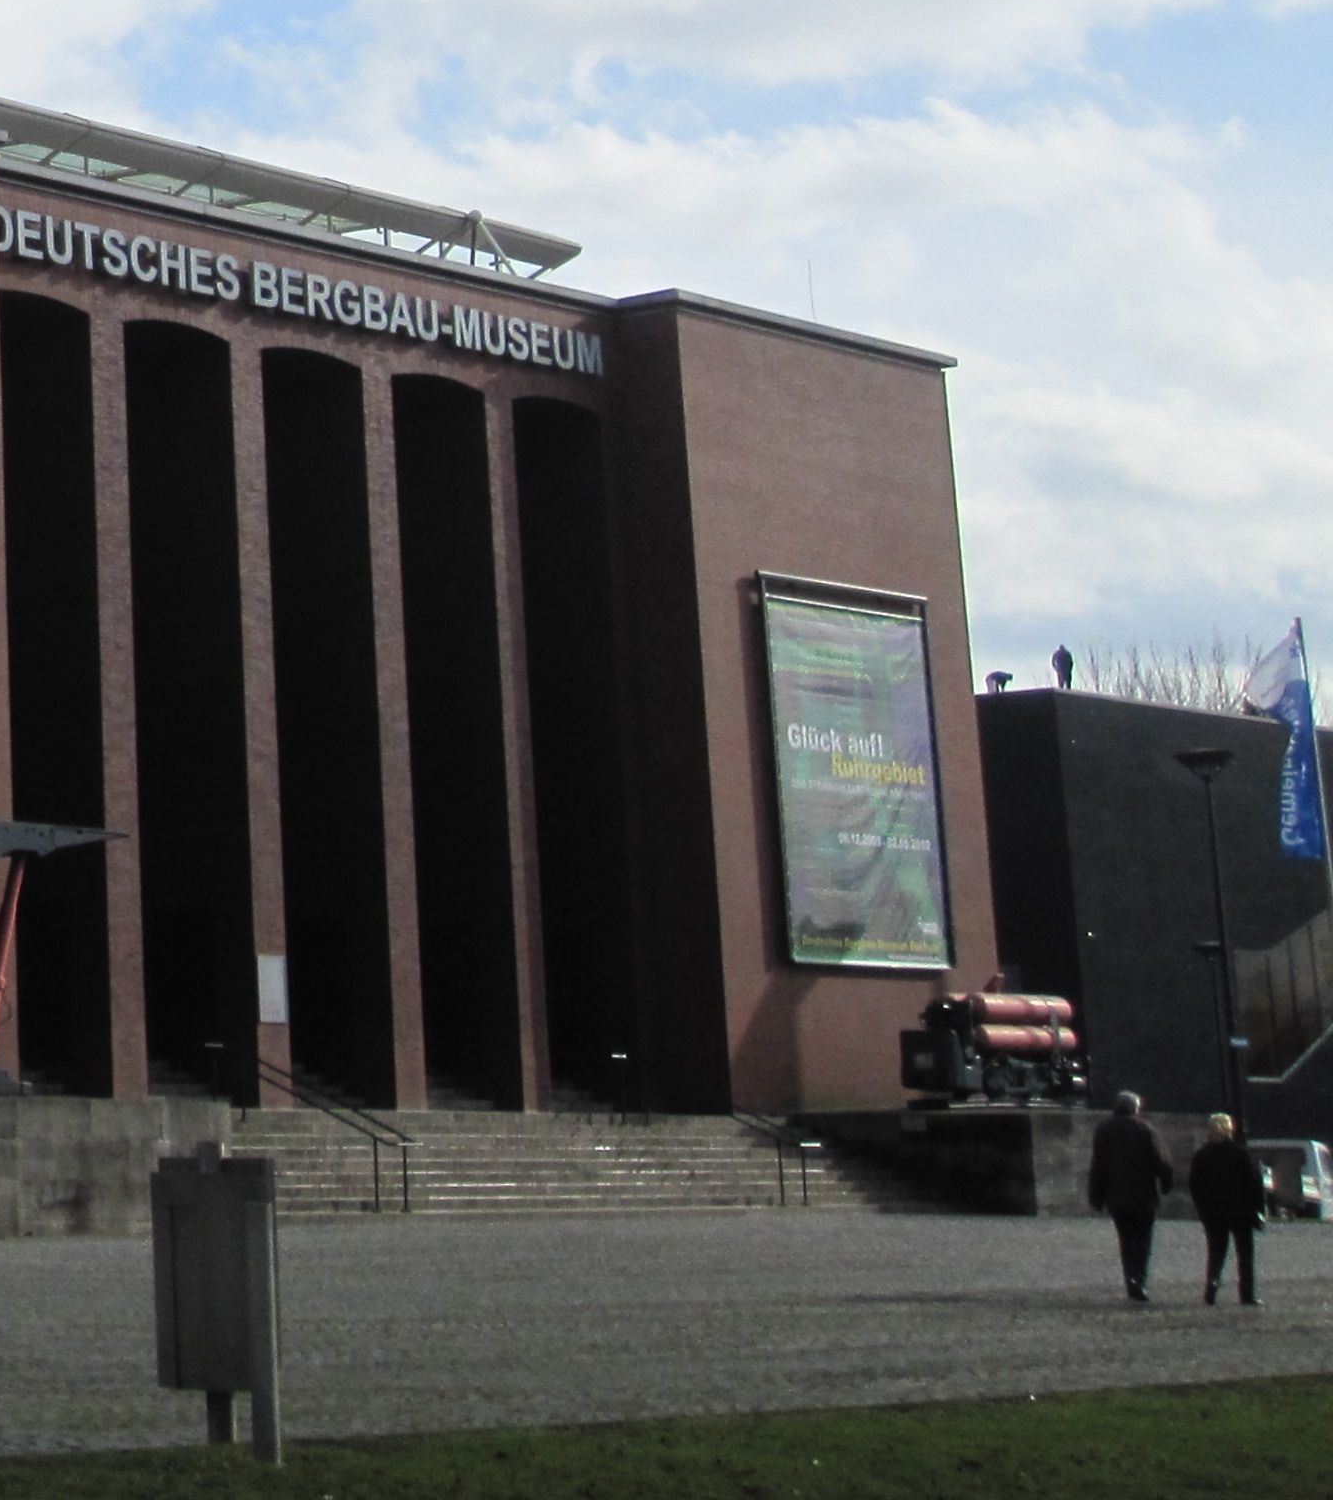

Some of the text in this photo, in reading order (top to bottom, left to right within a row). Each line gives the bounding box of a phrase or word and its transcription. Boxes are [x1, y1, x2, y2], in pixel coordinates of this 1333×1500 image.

[250, 260, 604, 376] BERGBAU-MUSEUM
[787, 722, 843, 752] Glück
[831, 751, 927, 787] Ruhrgebiet
